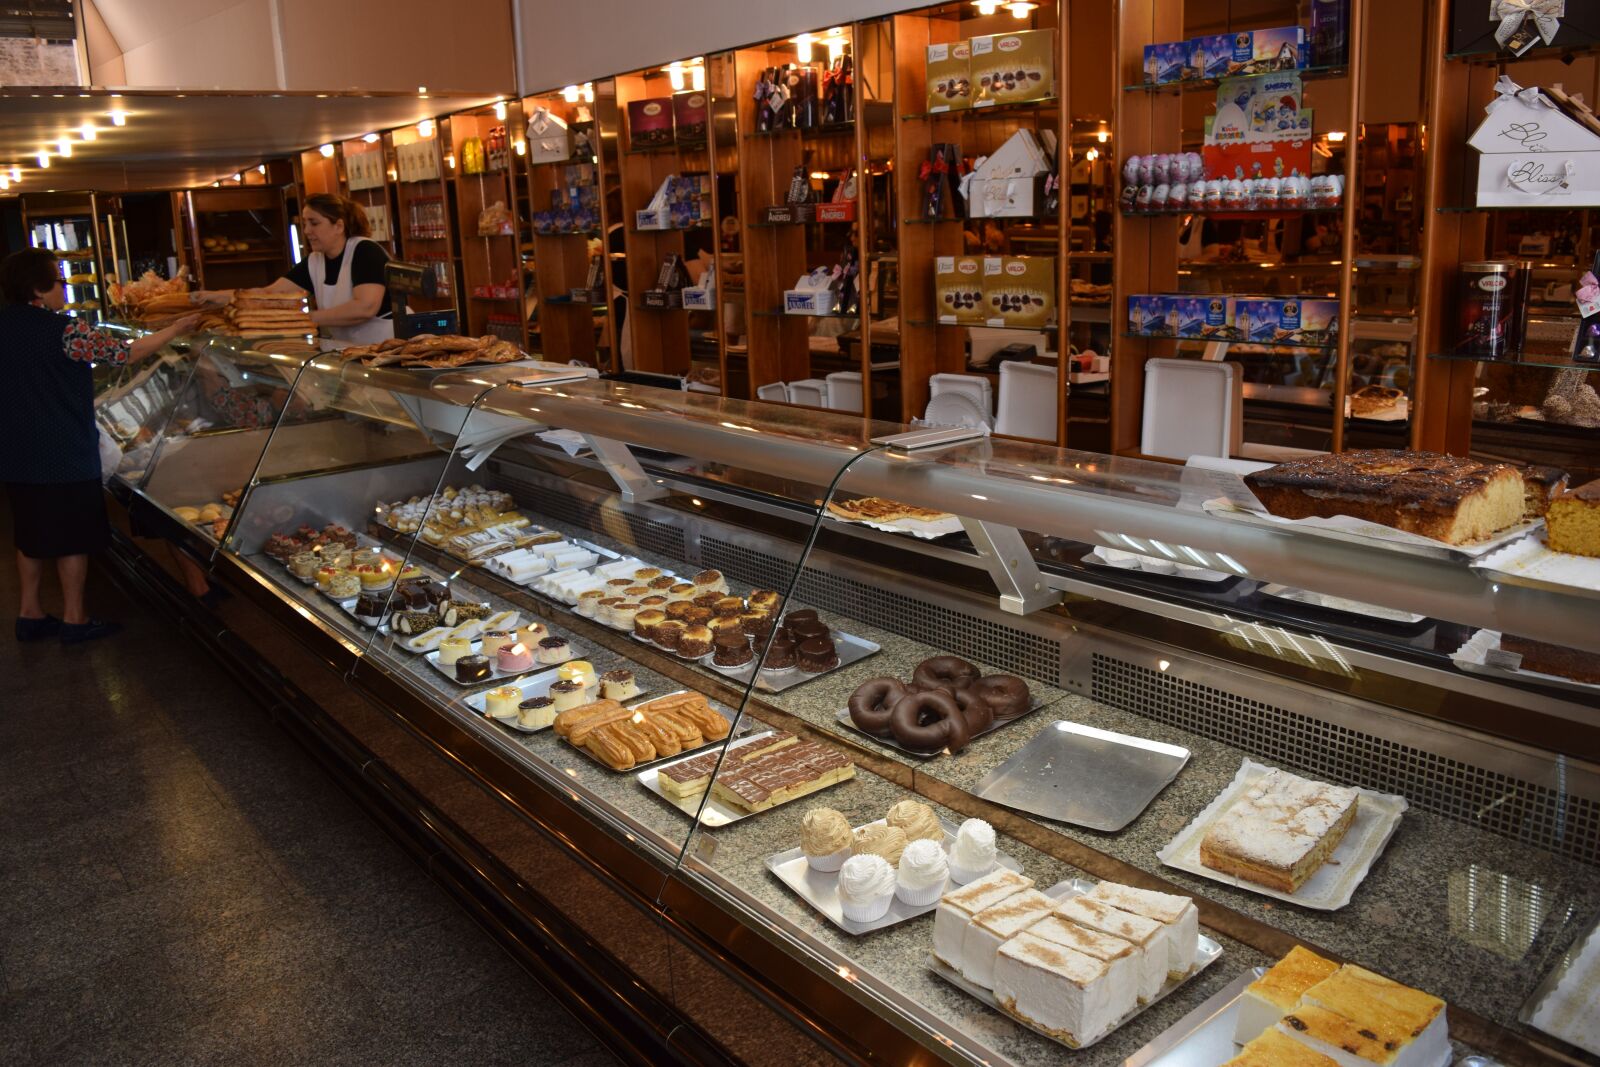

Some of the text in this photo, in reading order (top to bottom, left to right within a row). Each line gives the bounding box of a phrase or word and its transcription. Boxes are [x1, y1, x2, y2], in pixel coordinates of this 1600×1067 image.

[999, 40, 1020, 48] VALOR
[1511, 161, 1559, 183] Bliss
[768, 211, 791, 222] ANDREU
[821, 209, 846, 220] ANDREU
